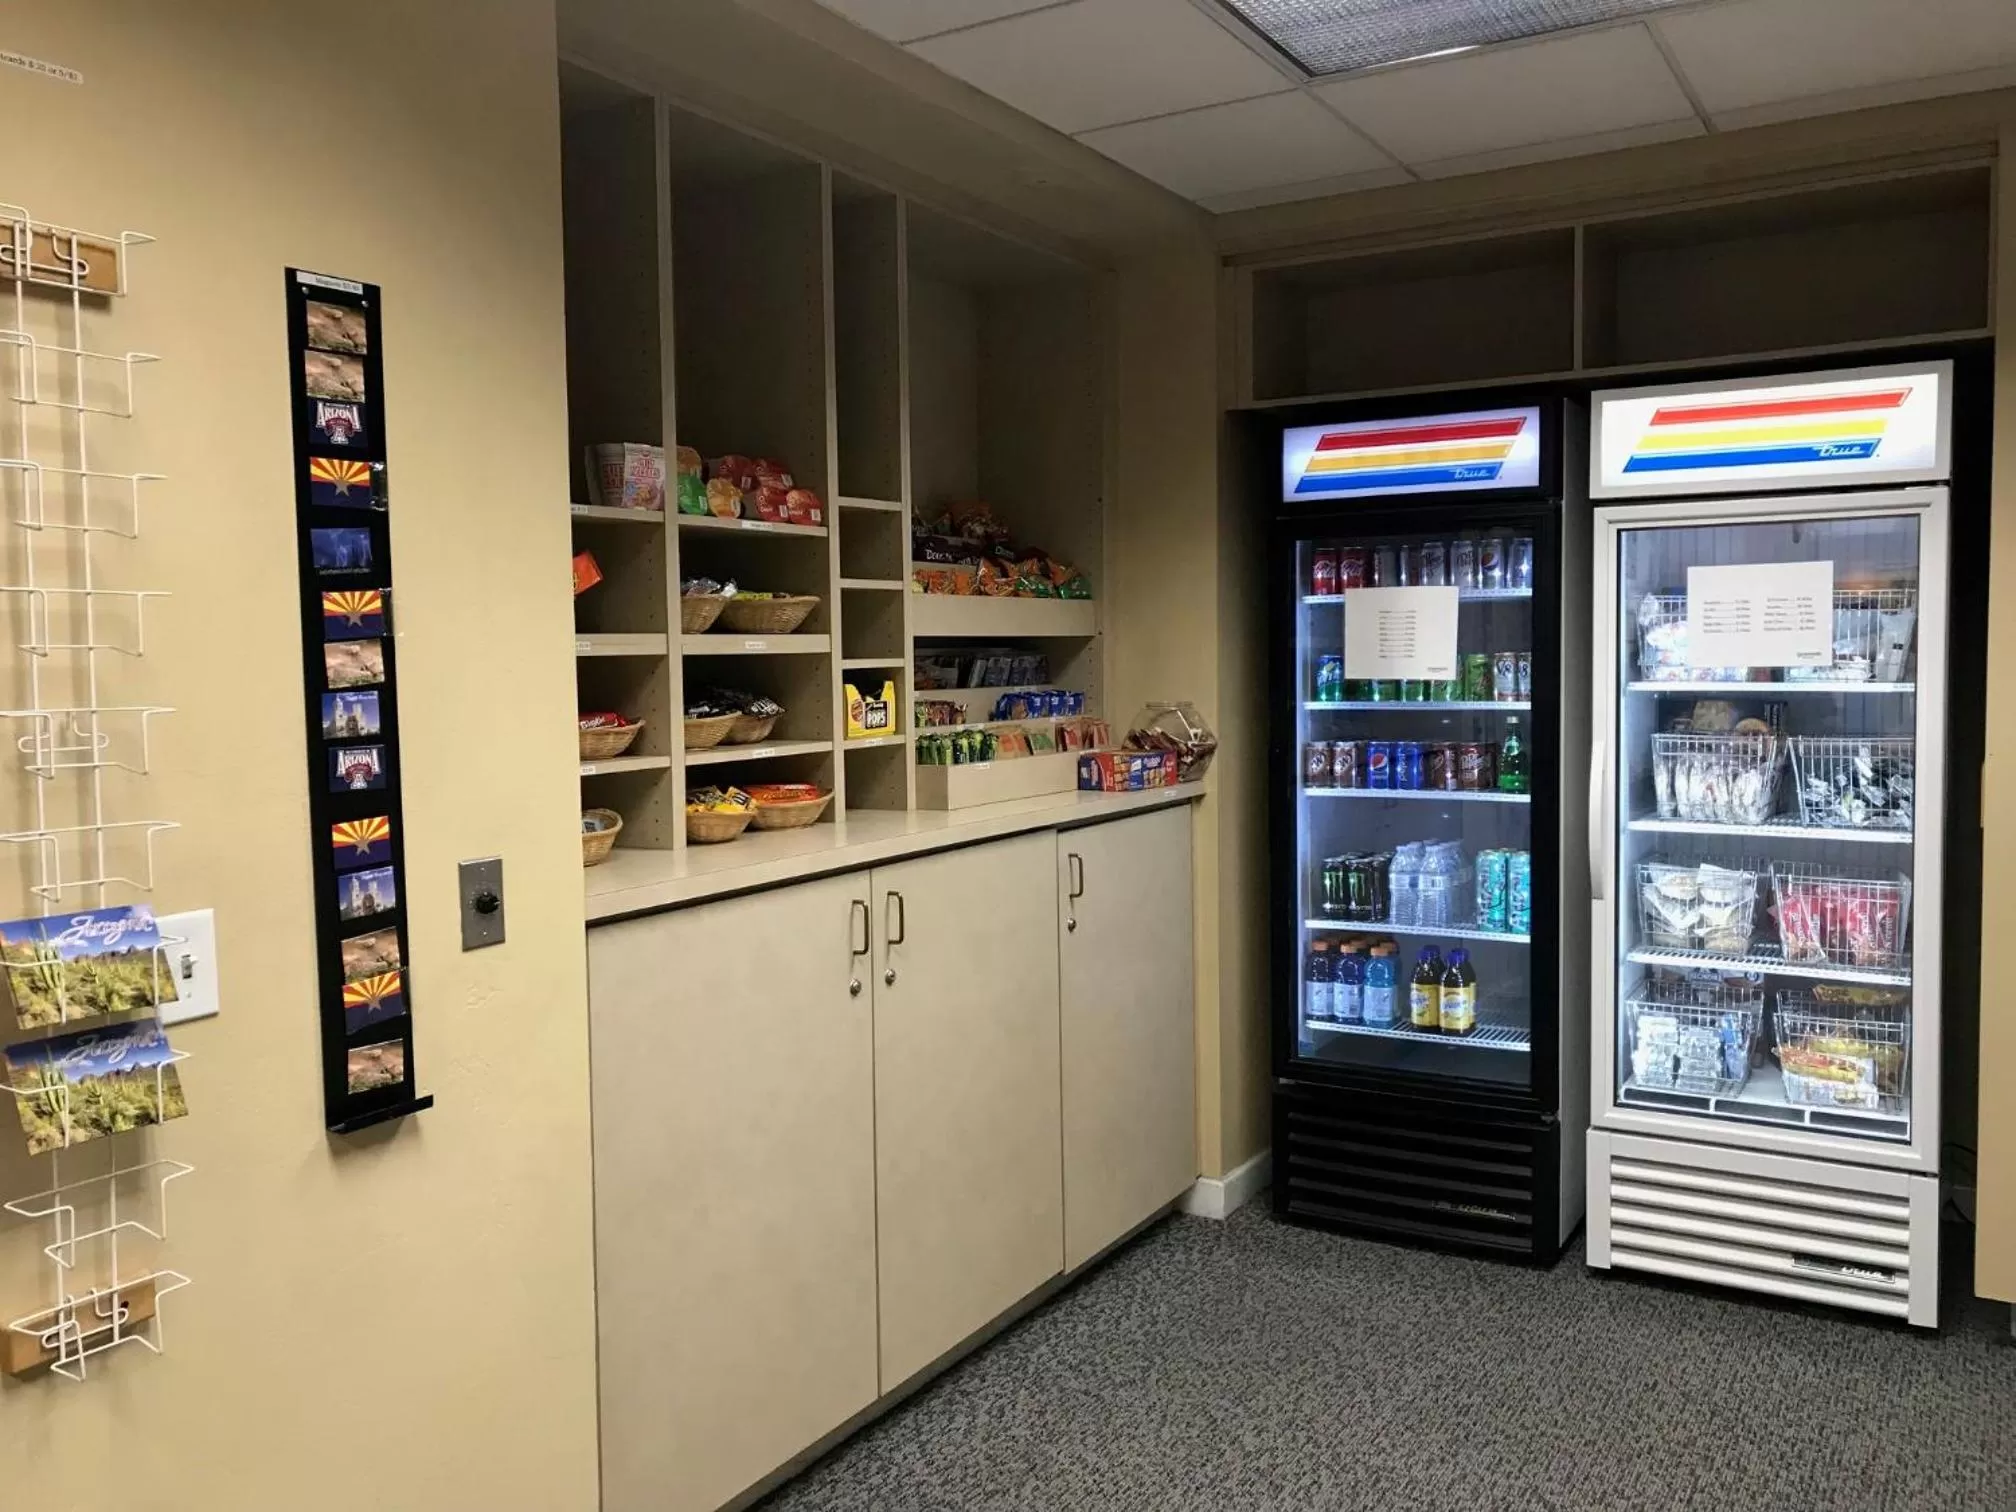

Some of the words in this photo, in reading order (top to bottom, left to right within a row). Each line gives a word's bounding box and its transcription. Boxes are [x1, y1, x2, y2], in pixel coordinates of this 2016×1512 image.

[315, 400, 362, 432] ARIZONA
[1496, 660, 1513, 677] V8
[336, 749, 381, 777] ARIZONA
